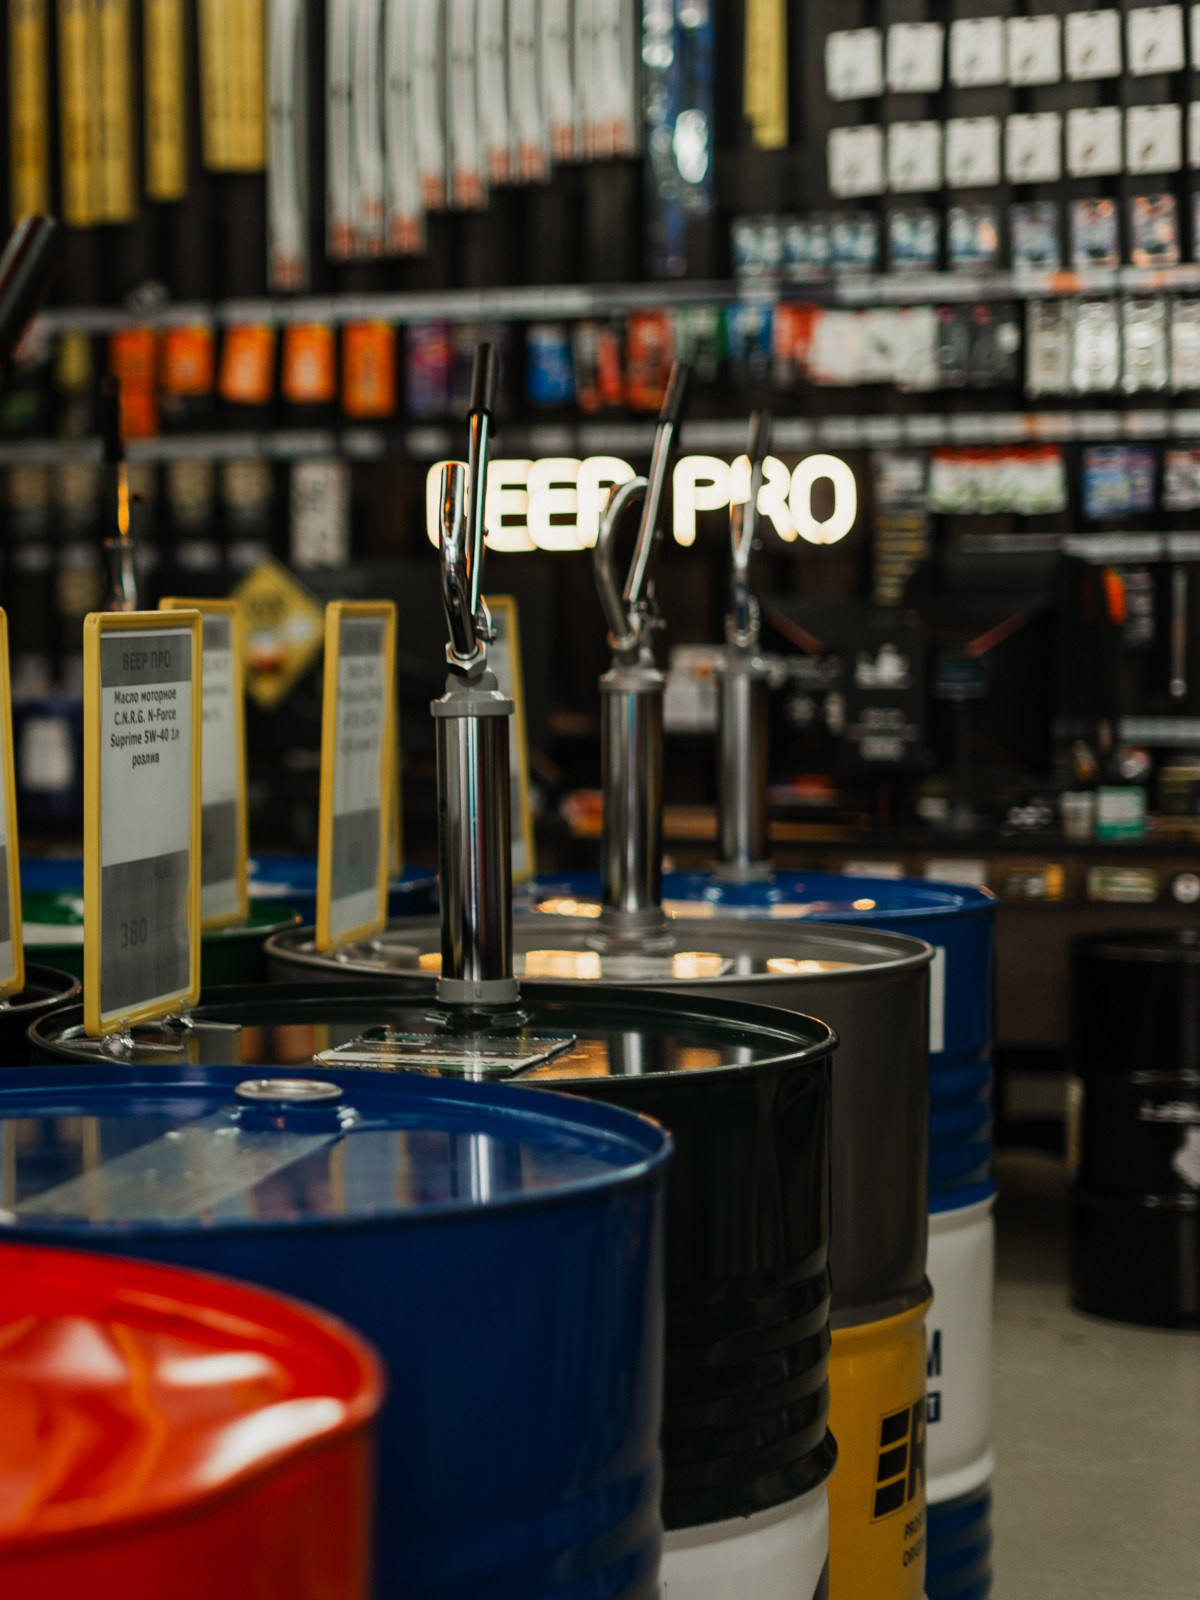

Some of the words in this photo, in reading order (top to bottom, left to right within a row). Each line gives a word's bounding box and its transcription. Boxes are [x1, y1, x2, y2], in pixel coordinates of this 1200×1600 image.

[673, 454, 857, 545] PRO
[122, 651, 148, 671] ВЕЕР
[150, 649, 172, 669] ПРО
[113, 690, 139, 705] Масло
[140, 688, 177, 704] моторное
[113, 709, 146, 727] C.N.R.G.
[147, 707, 177, 723] N-Force
[110, 731, 143, 750] Suprime
[144, 727, 170, 745] 5W-40
[131, 752, 160, 770] розлив
[120, 917, 147, 949] 380
